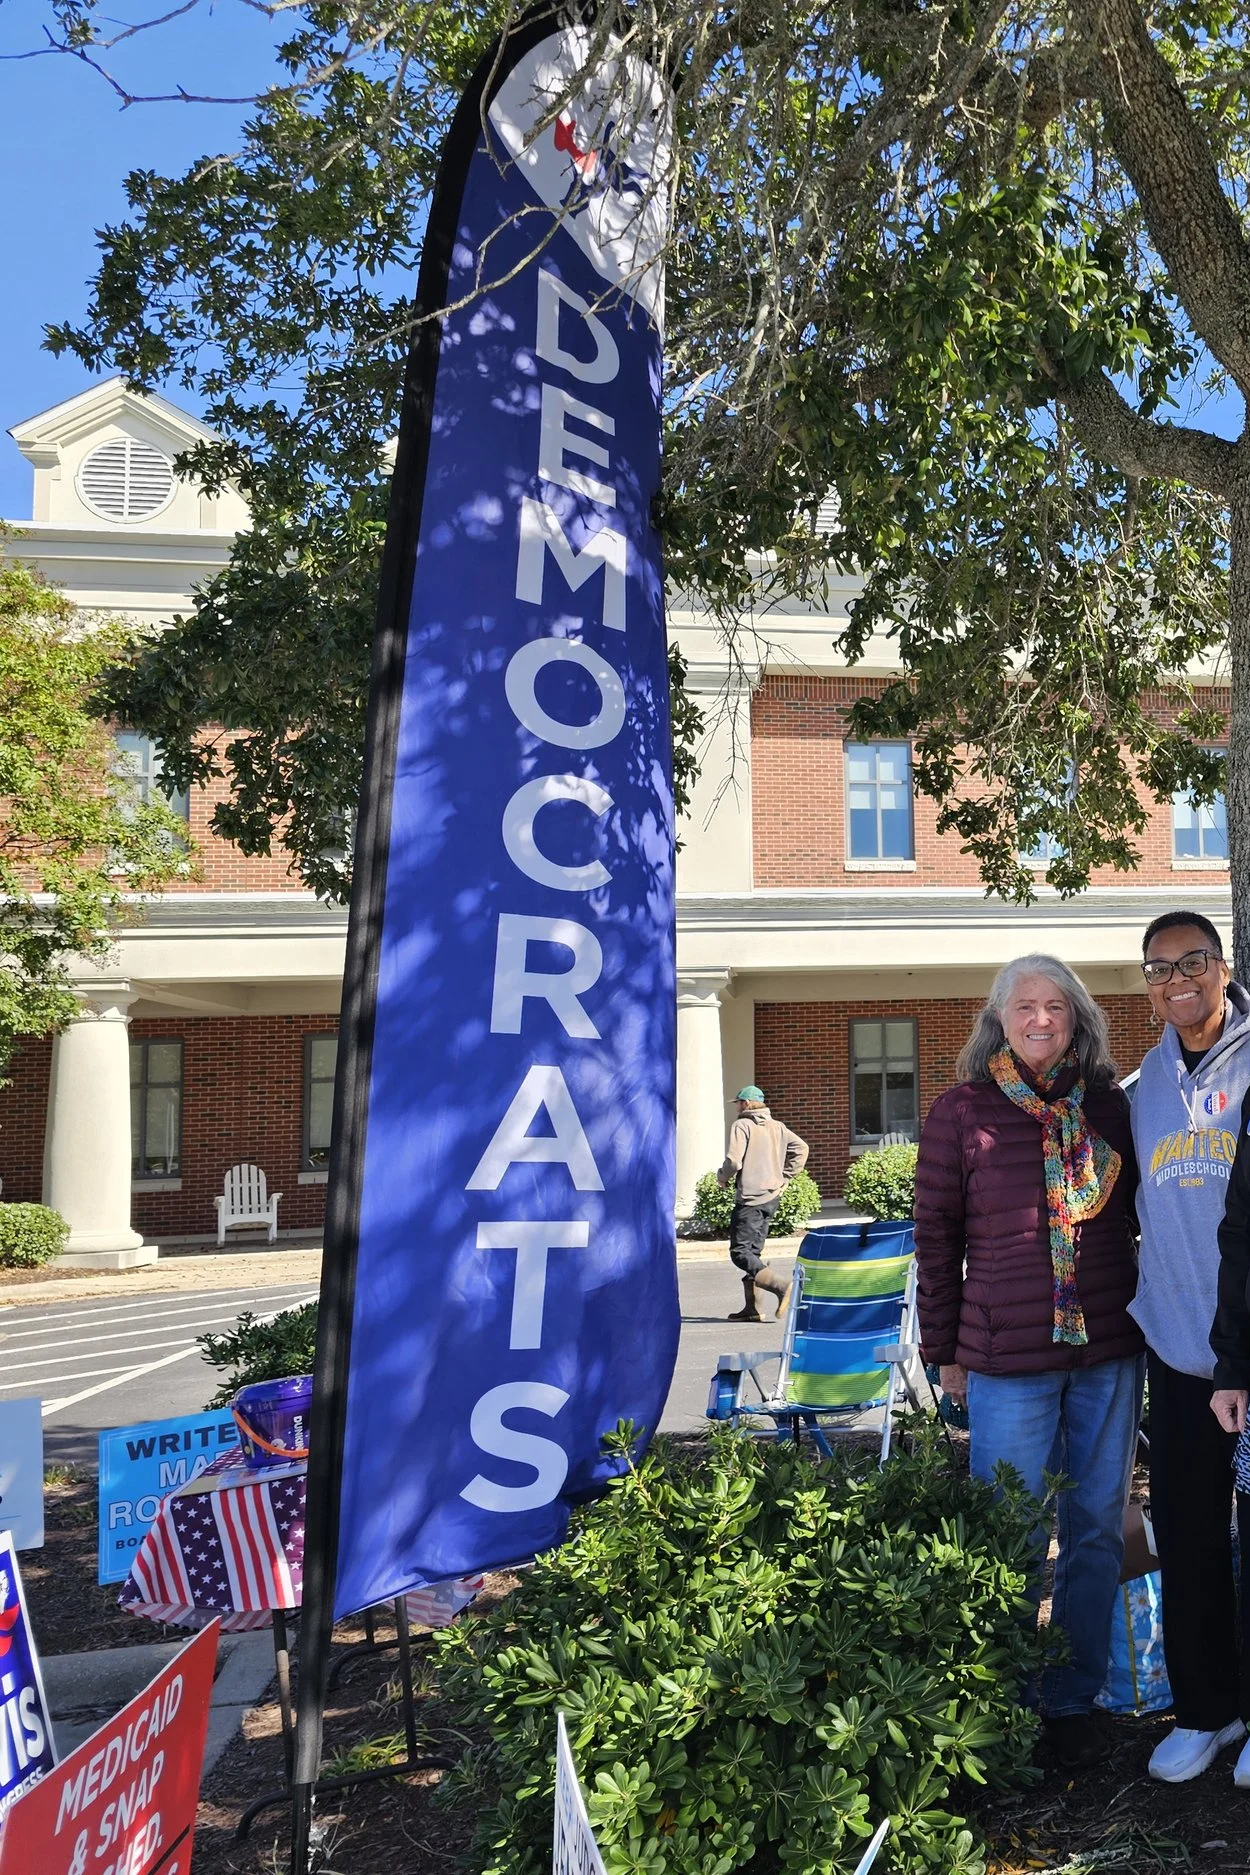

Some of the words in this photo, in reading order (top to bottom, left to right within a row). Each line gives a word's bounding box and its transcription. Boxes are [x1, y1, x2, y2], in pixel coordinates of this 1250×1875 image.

[459, 267, 627, 1513] DEMOCRATS
[1149, 1127, 1238, 1176] MANTEO
[126, 1421, 238, 1461] WRITE
[55, 1674, 184, 1836] MEDICAID
[95, 1750, 165, 1858] SNAP
